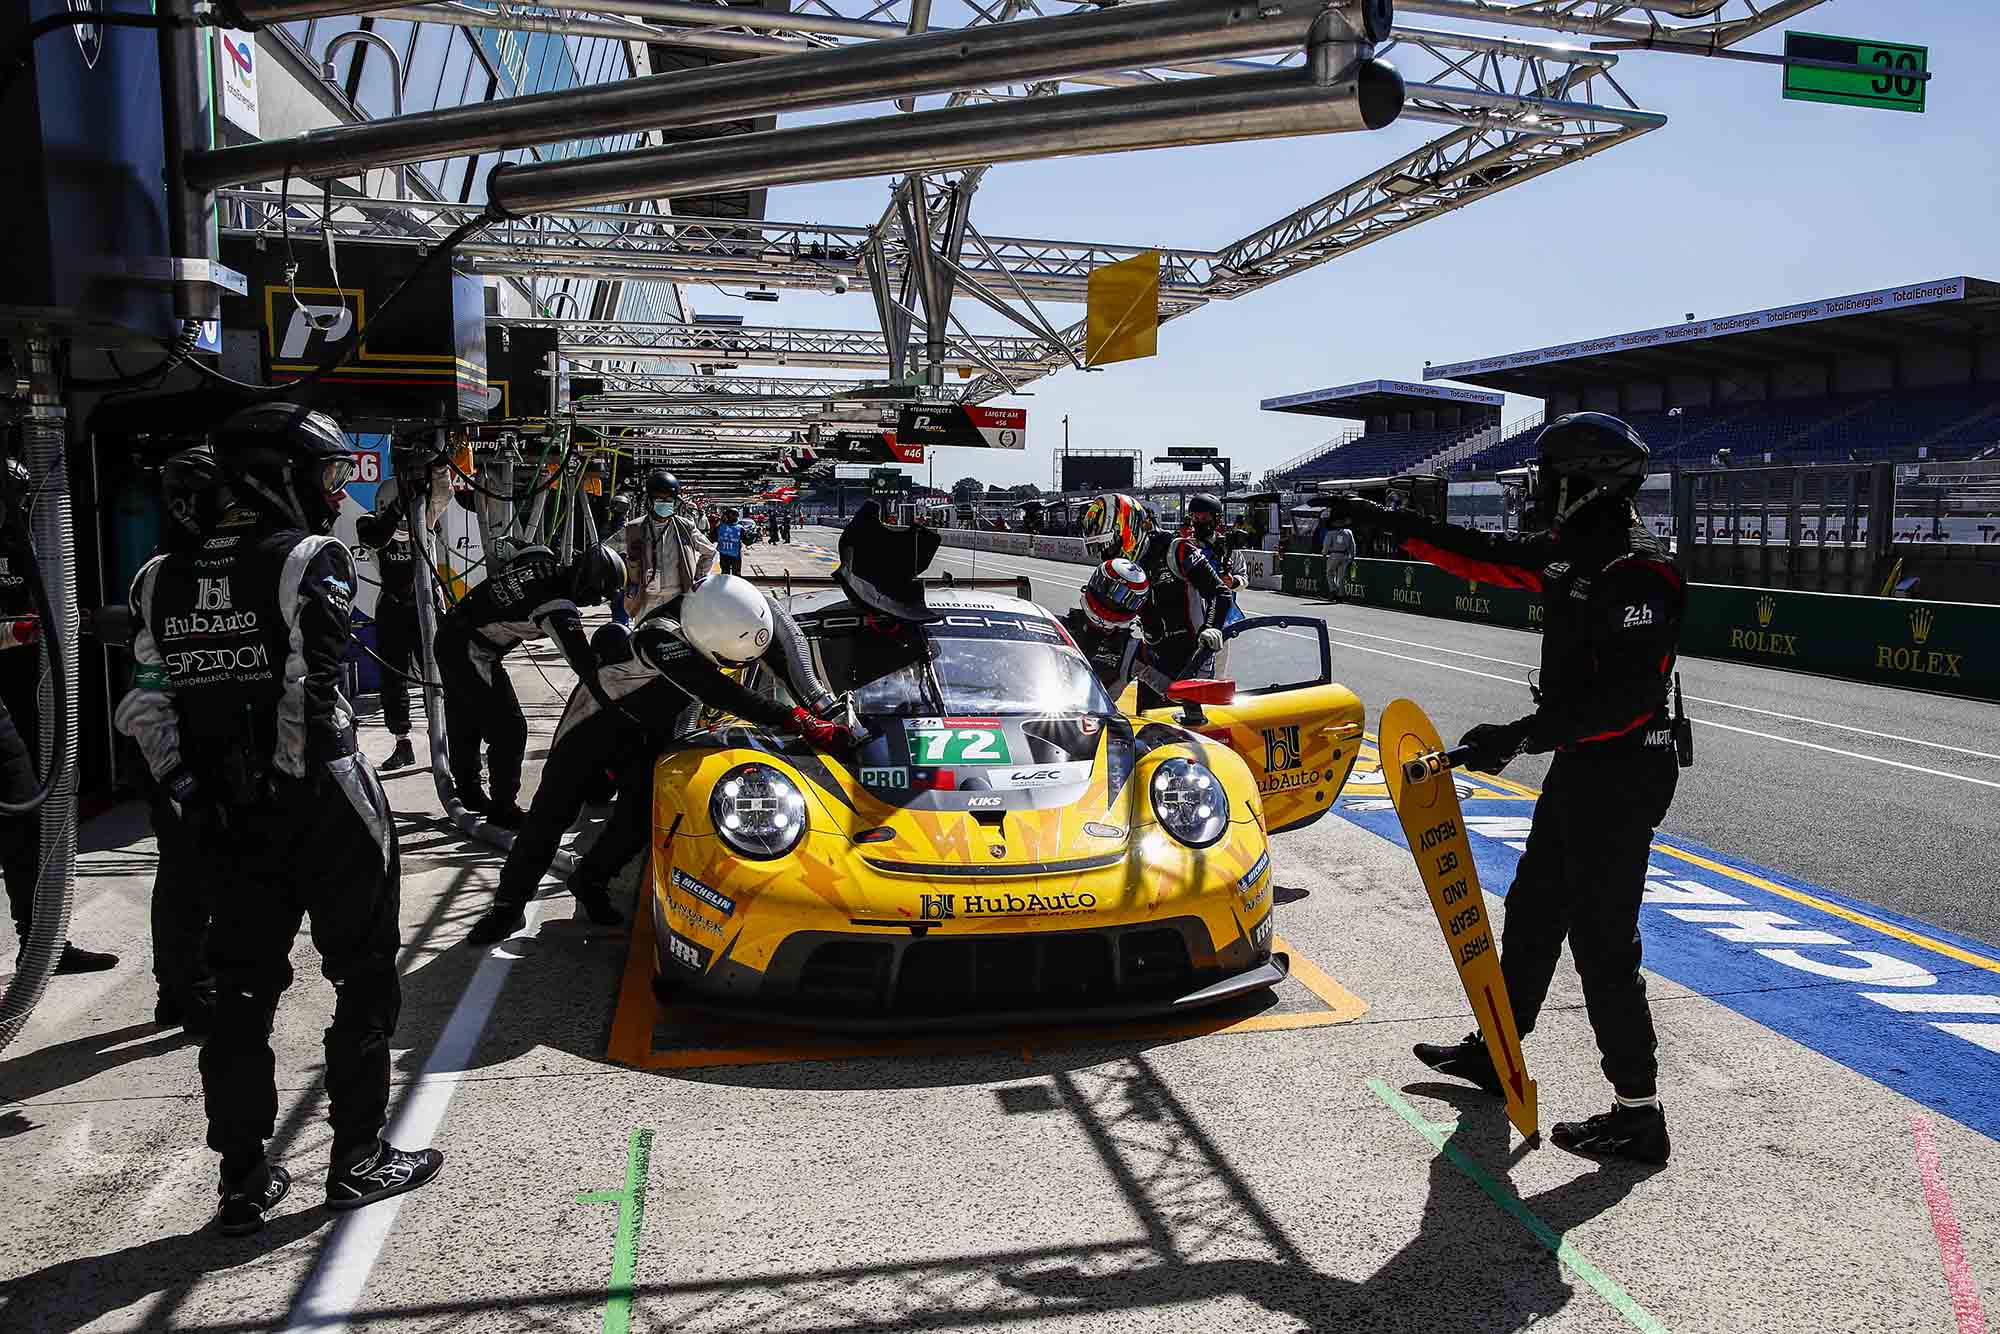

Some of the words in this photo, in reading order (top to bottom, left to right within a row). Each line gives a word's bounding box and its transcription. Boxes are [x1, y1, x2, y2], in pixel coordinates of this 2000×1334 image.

[1871, 50, 1917, 96] 30
[1664, 324, 1708, 339] TotalEnergies
[1712, 315, 1760, 333] TotalEnergies
[1766, 305, 1818, 323] TotalEnergies
[1824, 294, 1884, 313] TotalEnergies
[1892, 283, 1958, 304] TotalEnergies
[1393, 383, 1440, 396] TotalEnergies
[1449, 390, 1494, 401] TotalEnergies
[984, 410, 1007, 418] LMGTE
[904, 448, 921, 459] #46
[928, 600, 996, 611] auto.com
[1295, 577, 1319, 592] ROLEX
[1344, 582, 1366, 598] OLEX
[1393, 590, 1423, 606] ROLEX
[1455, 596, 1490, 614] ROLEX
[1731, 629, 1800, 656] ROLEX
[1875, 646, 1964, 678] ROLEX
[1632, 619, 1653, 627] MANS
[915, 730, 1001, 760] 72
[862, 770, 906, 788] PRO
[1011, 770, 1061, 780] WEC
[1256, 769, 1320, 793] ubAuto
[967, 797, 1001, 806] KIKS
[1419, 818, 1457, 853] READY
[1435, 850, 1458, 876] GET
[681, 877, 732, 910] MICHELIN
[963, 891, 1097, 914] HubAuto
[1443, 877, 1469, 905] AND
[1450, 906, 1480, 937] GEAR
[1459, 932, 1490, 967] FIRST
